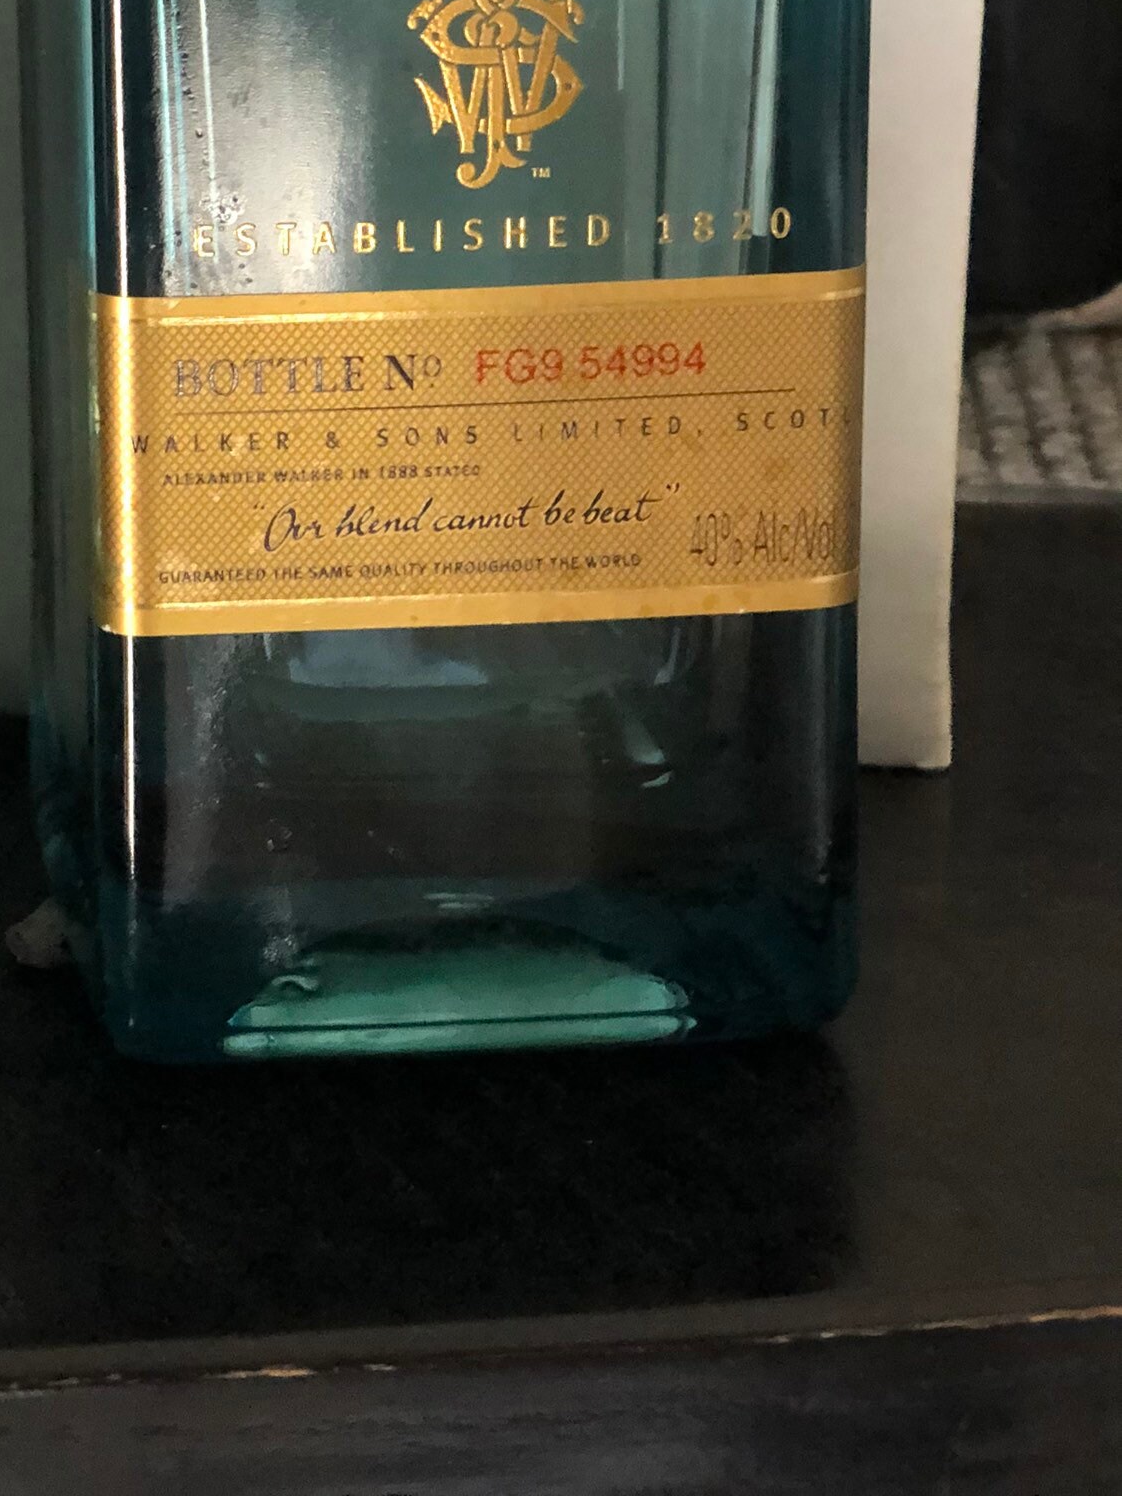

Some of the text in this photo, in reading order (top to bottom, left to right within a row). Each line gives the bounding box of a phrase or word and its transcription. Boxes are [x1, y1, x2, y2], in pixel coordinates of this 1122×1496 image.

[191, 206, 793, 258] ESTABLISHED 1820
[174, 354, 365, 397] BOTTLE
[476, 347, 566, 386] FG9
[578, 340, 708, 381] 54994
[131, 431, 290, 455] WALKER
[325, 430, 341, 449] &
[377, 425, 479, 448] SONS
[162, 470, 267, 487] ALEXANDER
[273, 467, 345, 484] WALKER
[352, 467, 369, 481] IN
[378, 464, 419, 480] 1888
[335, 497, 434, 539] blend
[433, 497, 540, 533] cannot
[544, 489, 576, 526] be
[158, 553, 642, 585] GUARANTEED THE SAME QUALITY THROUGHOUT THE WORLD
